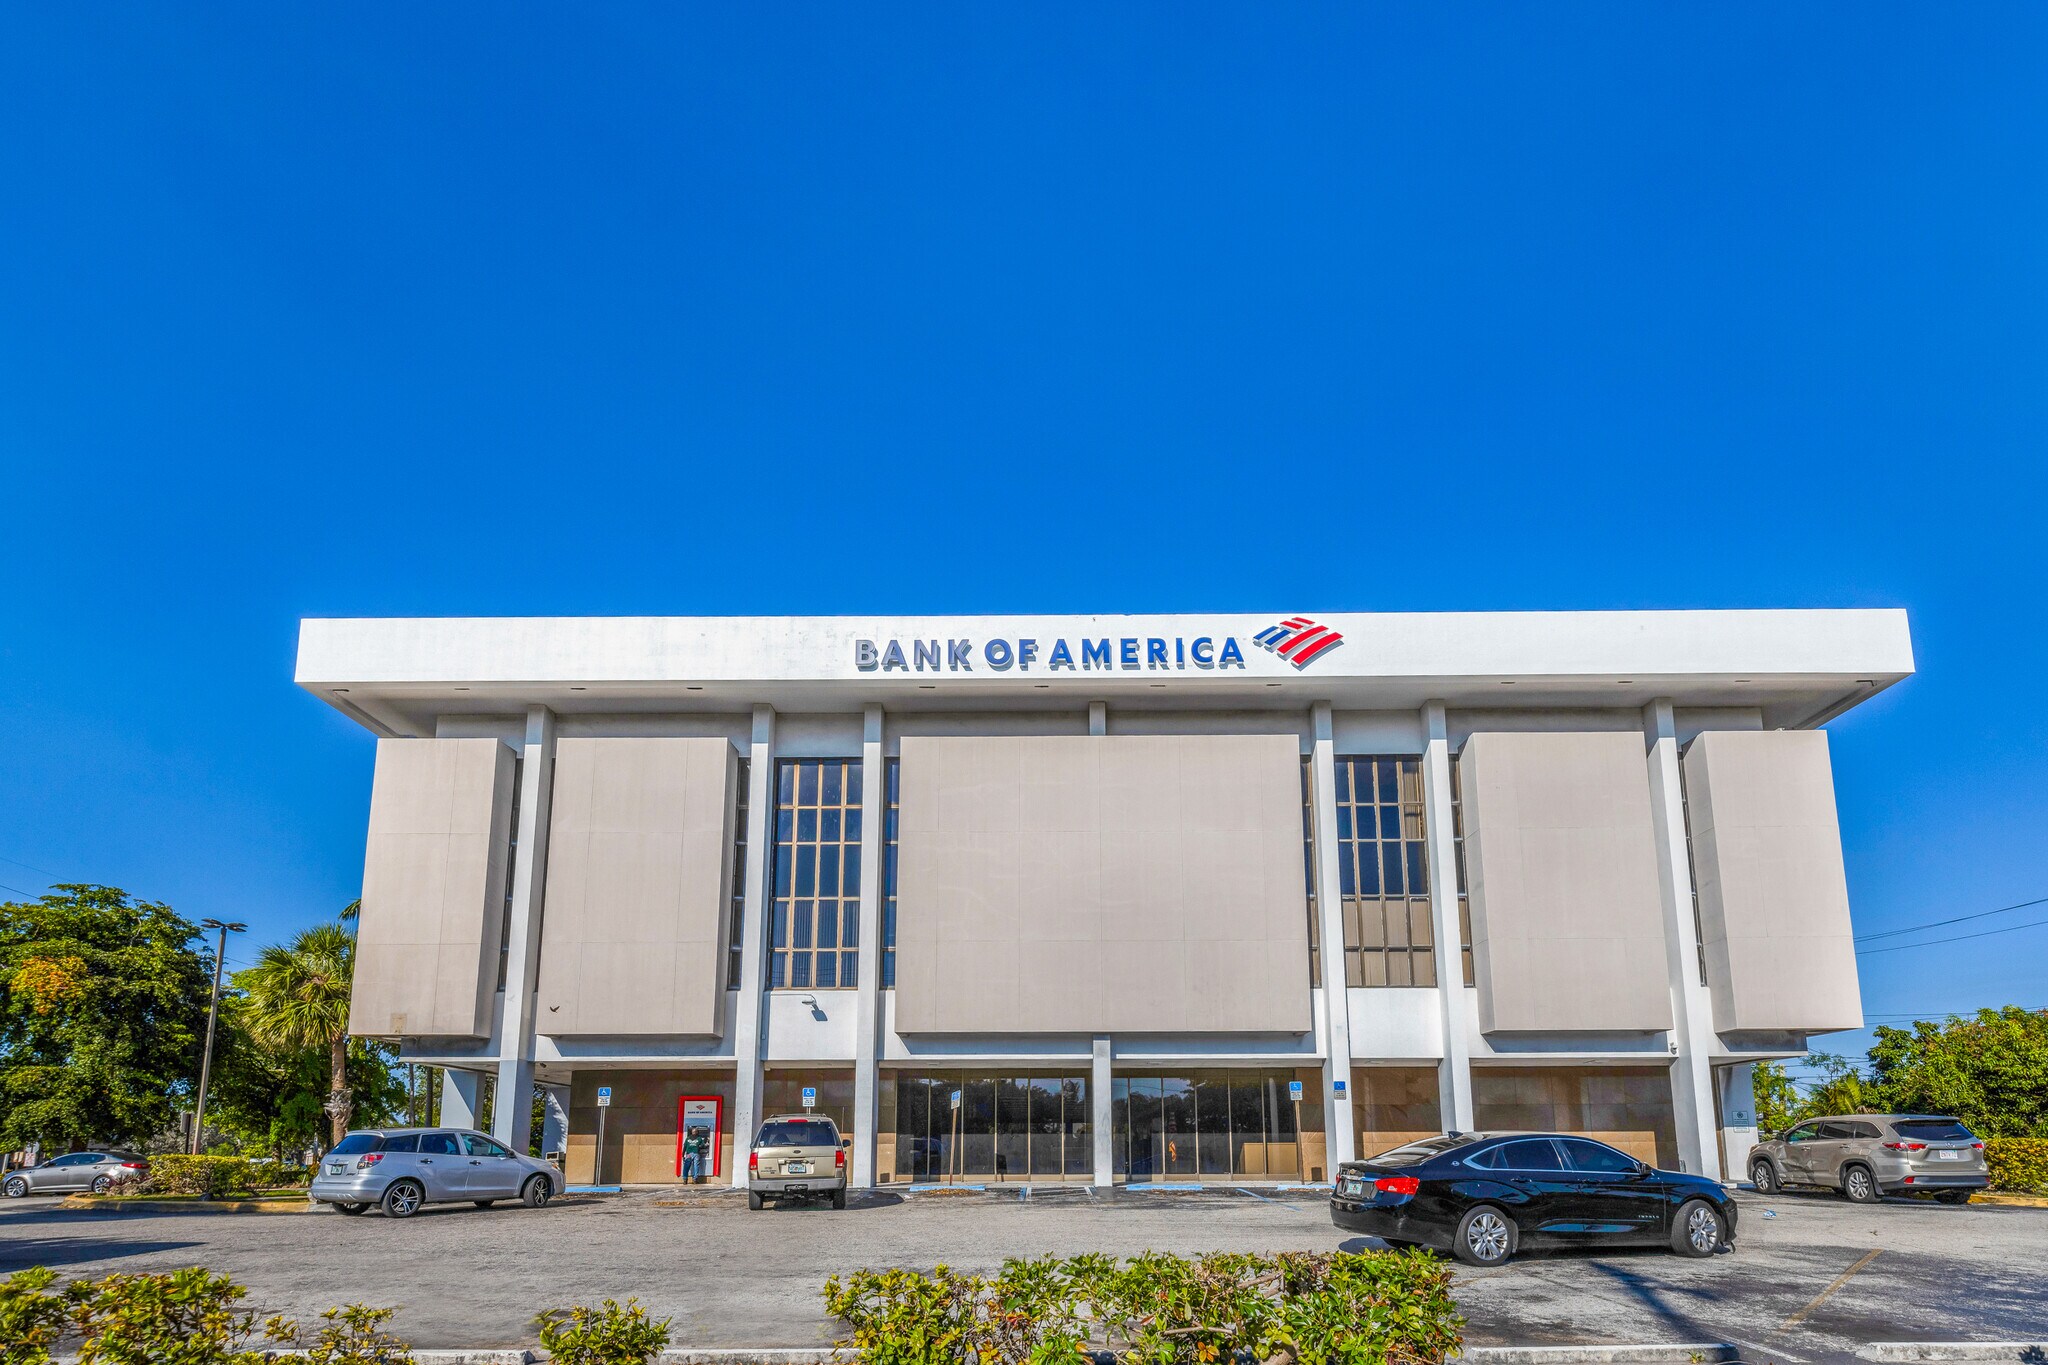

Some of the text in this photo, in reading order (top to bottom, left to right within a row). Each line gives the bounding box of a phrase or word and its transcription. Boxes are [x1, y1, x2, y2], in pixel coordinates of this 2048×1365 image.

[855, 637, 1245, 669] BANK OF AMERICA
